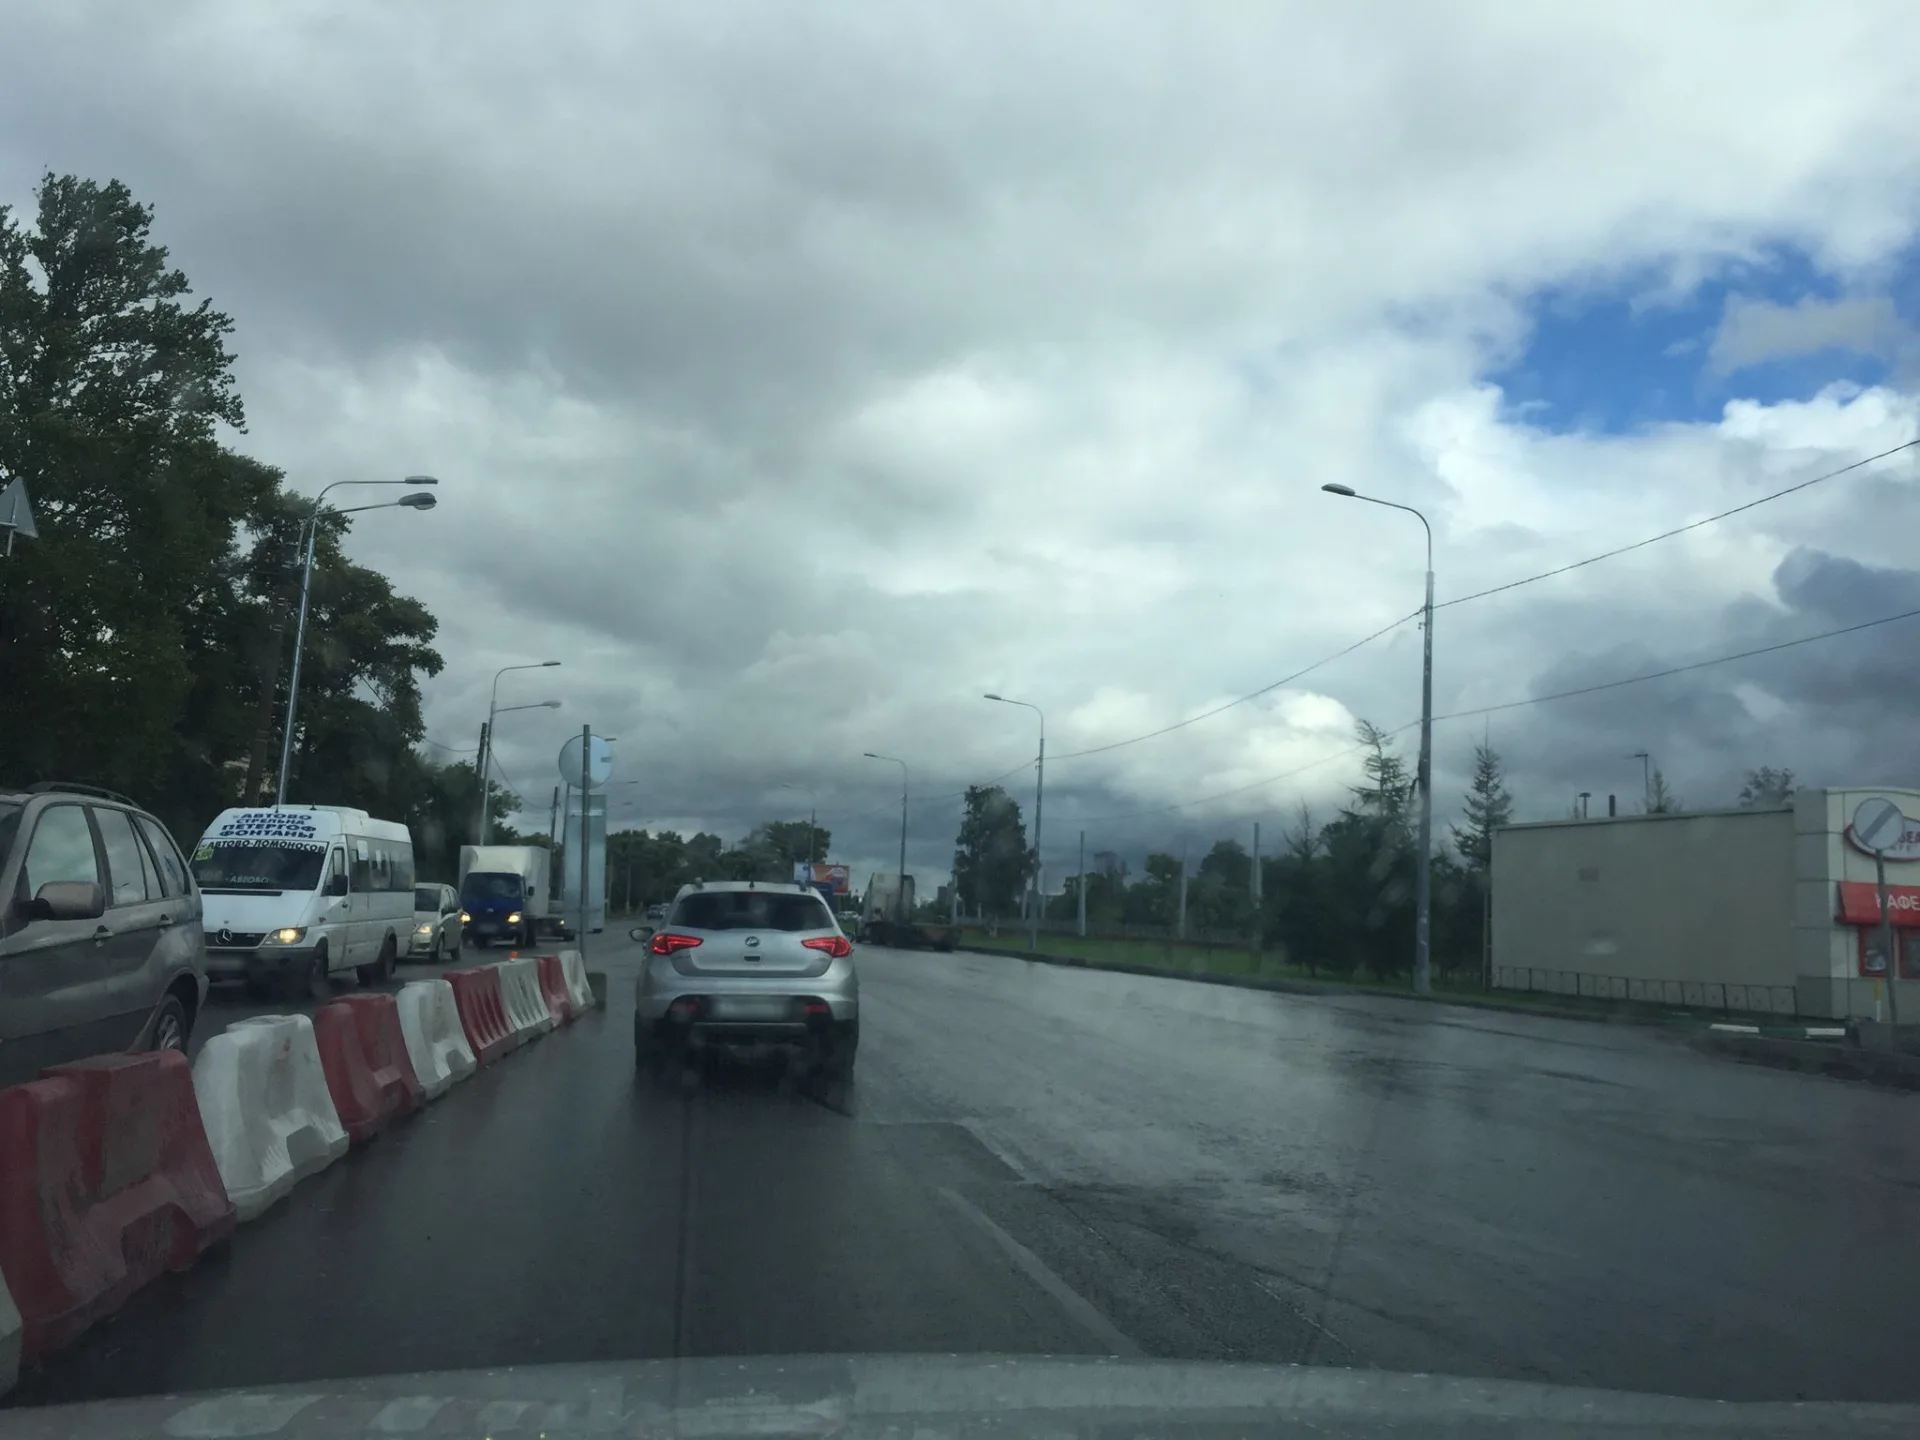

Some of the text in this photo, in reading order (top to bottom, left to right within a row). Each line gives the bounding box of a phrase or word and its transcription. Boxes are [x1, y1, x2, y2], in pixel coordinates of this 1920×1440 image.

[241, 813, 312, 821] АВТОВО
[221, 823, 317, 832] ПЕТЕРГОФ
[219, 830, 315, 839] ФОНТАНЫ
